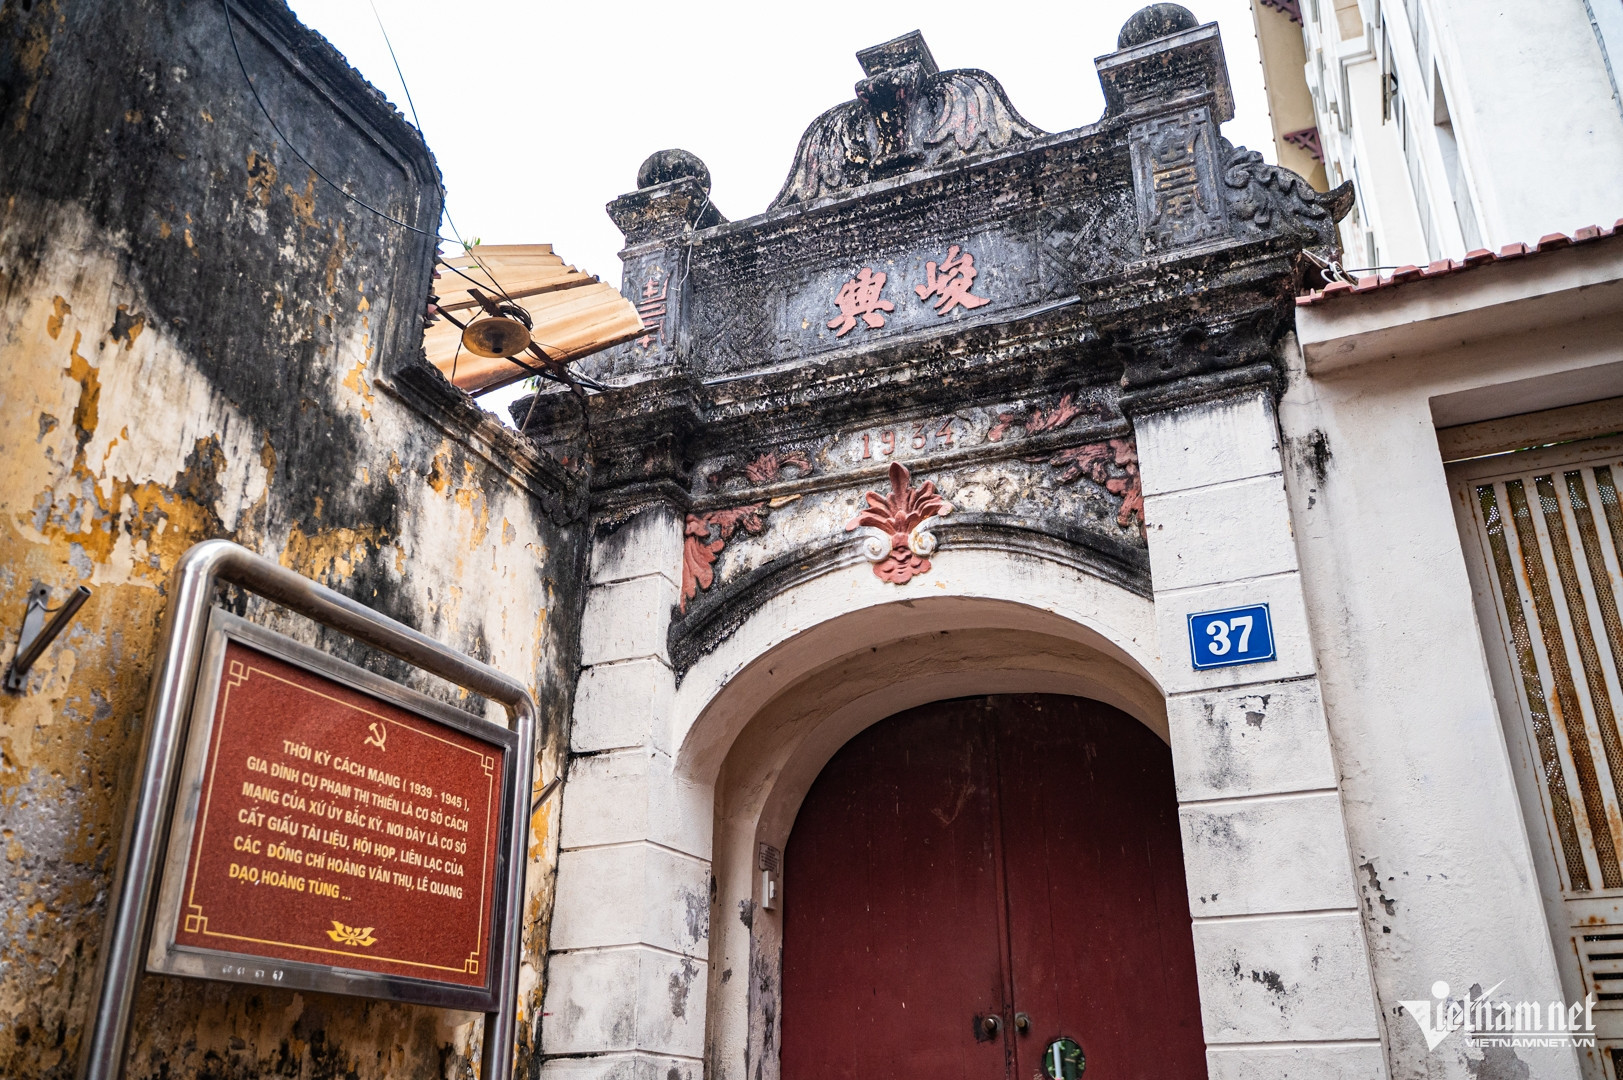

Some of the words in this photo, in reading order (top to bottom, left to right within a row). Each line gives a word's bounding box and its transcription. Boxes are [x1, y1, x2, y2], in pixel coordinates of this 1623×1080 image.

[862, 416, 954, 459] 1934
[1206, 615, 1253, 656] 37
[246, 756, 268, 774] GIA
[271, 761, 300, 783] ĐÌNH
[301, 772, 318, 792] CỤ
[320, 778, 351, 799] PHẠM
[354, 788, 370, 807] THỊ
[401, 801, 413, 816] LÀ
[415, 807, 429, 820] CƠ
[430, 808, 443, 825] SỞ
[444, 814, 469, 832] CÁCH
[283, 740, 312, 760] THỜI
[314, 750, 331, 766] KỲ
[333, 756, 366, 777] CÁCH
[367, 767, 401, 788] MẠNG
[409, 782, 433, 798] 1939
[440, 792, 462, 808] 1945
[238, 806, 266, 827] CẤT
[267, 815, 299, 836] GIẤU
[301, 823, 320, 841] TÀI
[323, 829, 350, 850] LIỆU,
[353, 837, 372, 857] HỘI
[373, 843, 398, 862] HỌP,
[400, 849, 422, 866] LIÊN
[424, 856, 443, 873] LẠC
[444, 858, 464, 876] CỦA
[242, 782, 280, 803] MẠNG
[282, 789, 306, 811] CỦA
[308, 800, 327, 816] XỨ
[327, 800, 343, 820] ỦY
[345, 805, 367, 827] BẮC
[367, 815, 384, 833] KỲ.
[386, 822, 404, 837] NƠI
[405, 826, 426, 842] ĐÂY
[427, 832, 438, 847] LÀ
[440, 837, 453, 850] CƠ
[454, 838, 467, 854] SỞ
[228, 863, 260, 886] ĐẠO,
[261, 869, 306, 892] HOÀNG
[308, 877, 340, 898] TÙNG
[233, 834, 262, 854] CÁC
[267, 840, 303, 864] ĐỒNG
[305, 852, 326, 869] CHÍ
[326, 857, 366, 878] HOÀNG
[368, 865, 391, 883] VĂN
[393, 872, 415, 892] THỤ,
[416, 876, 429, 891] LÊ
[430, 881, 463, 899] QUANG
